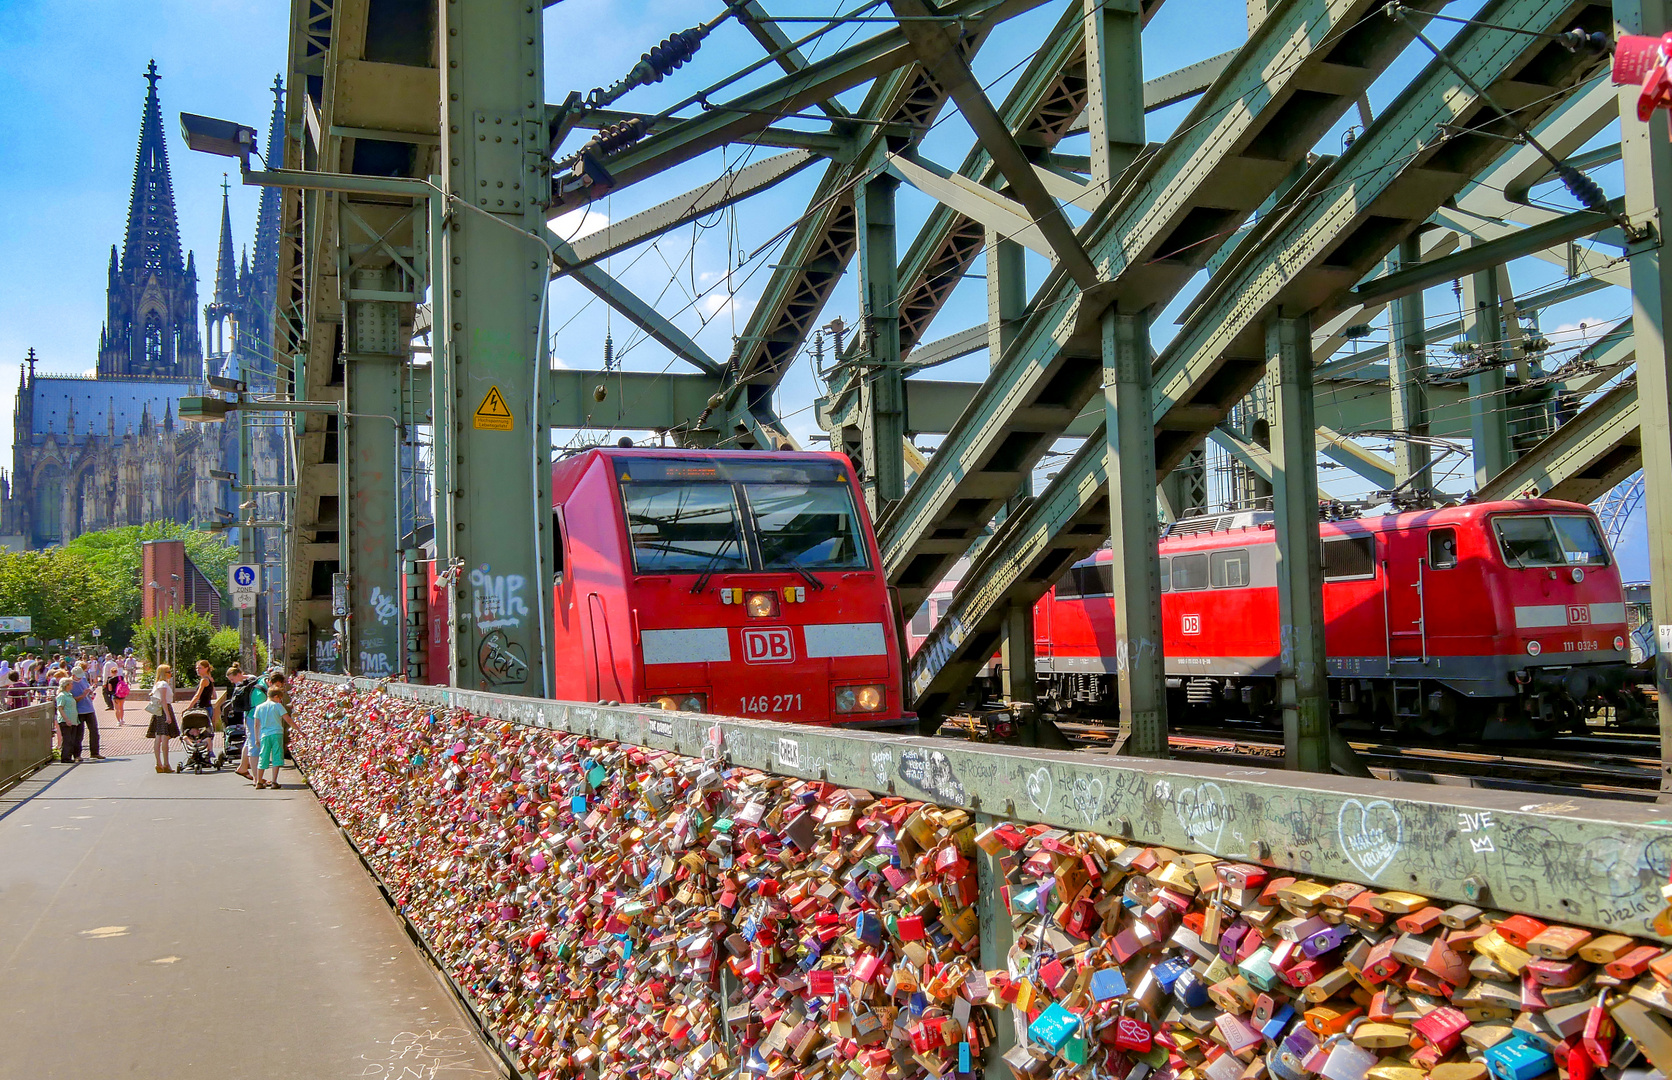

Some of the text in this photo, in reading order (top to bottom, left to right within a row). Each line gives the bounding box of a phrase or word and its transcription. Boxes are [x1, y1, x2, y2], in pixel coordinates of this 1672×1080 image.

[1571, 608, 1588, 621] DB
[1184, 617, 1198, 632] DB
[749, 633, 788, 658] DB
[1563, 640, 1598, 651] 111 032-9
[740, 694, 801, 713] 146 271
